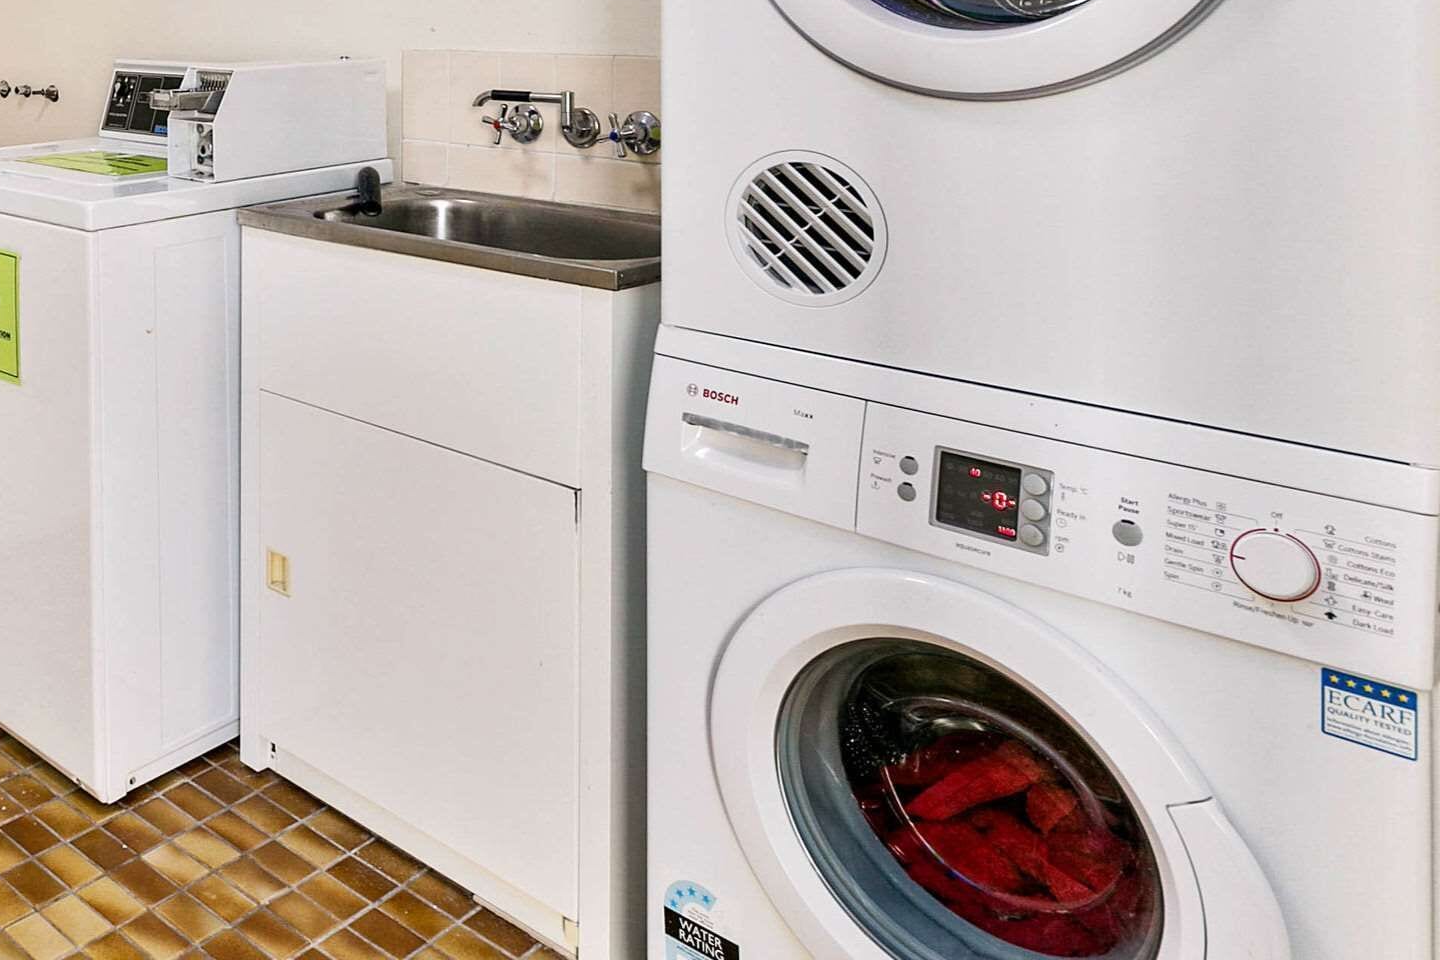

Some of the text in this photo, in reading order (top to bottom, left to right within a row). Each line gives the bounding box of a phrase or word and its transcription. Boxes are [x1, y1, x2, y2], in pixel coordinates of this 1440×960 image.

[703, 389, 739, 405] BOSCH
[1120, 497, 1139, 506] Start
[1168, 493, 1208, 507] Allergy Plus
[1118, 505, 1140, 515] Pause
[1167, 506, 1211, 521] Sportswear
[1271, 511, 1283, 520] Off
[1166, 519, 1186, 529] Super
[1165, 532, 1205, 546] Mixed Load
[1364, 536, 1397, 549] Cottons
[1164, 544, 1183, 554] Drain
[1337, 544, 1369, 557] Cottons
[1164, 558, 1204, 573] Gentle Spin
[1346, 561, 1396, 577] Cottons Eco
[1164, 570, 1179, 580] Spin
[1343, 574, 1394, 591] Delicate/Silk
[1374, 595, 1394, 606] Wool
[1352, 604, 1394, 620] Easy Care
[1352, 619, 1394, 635] Dark Load
[1328, 690, 1413, 725] ECARF
[1327, 707, 1412, 736] QUALITY TESTED
[679, 918, 723, 949] WATER
[679, 929, 725, 960] RATING
